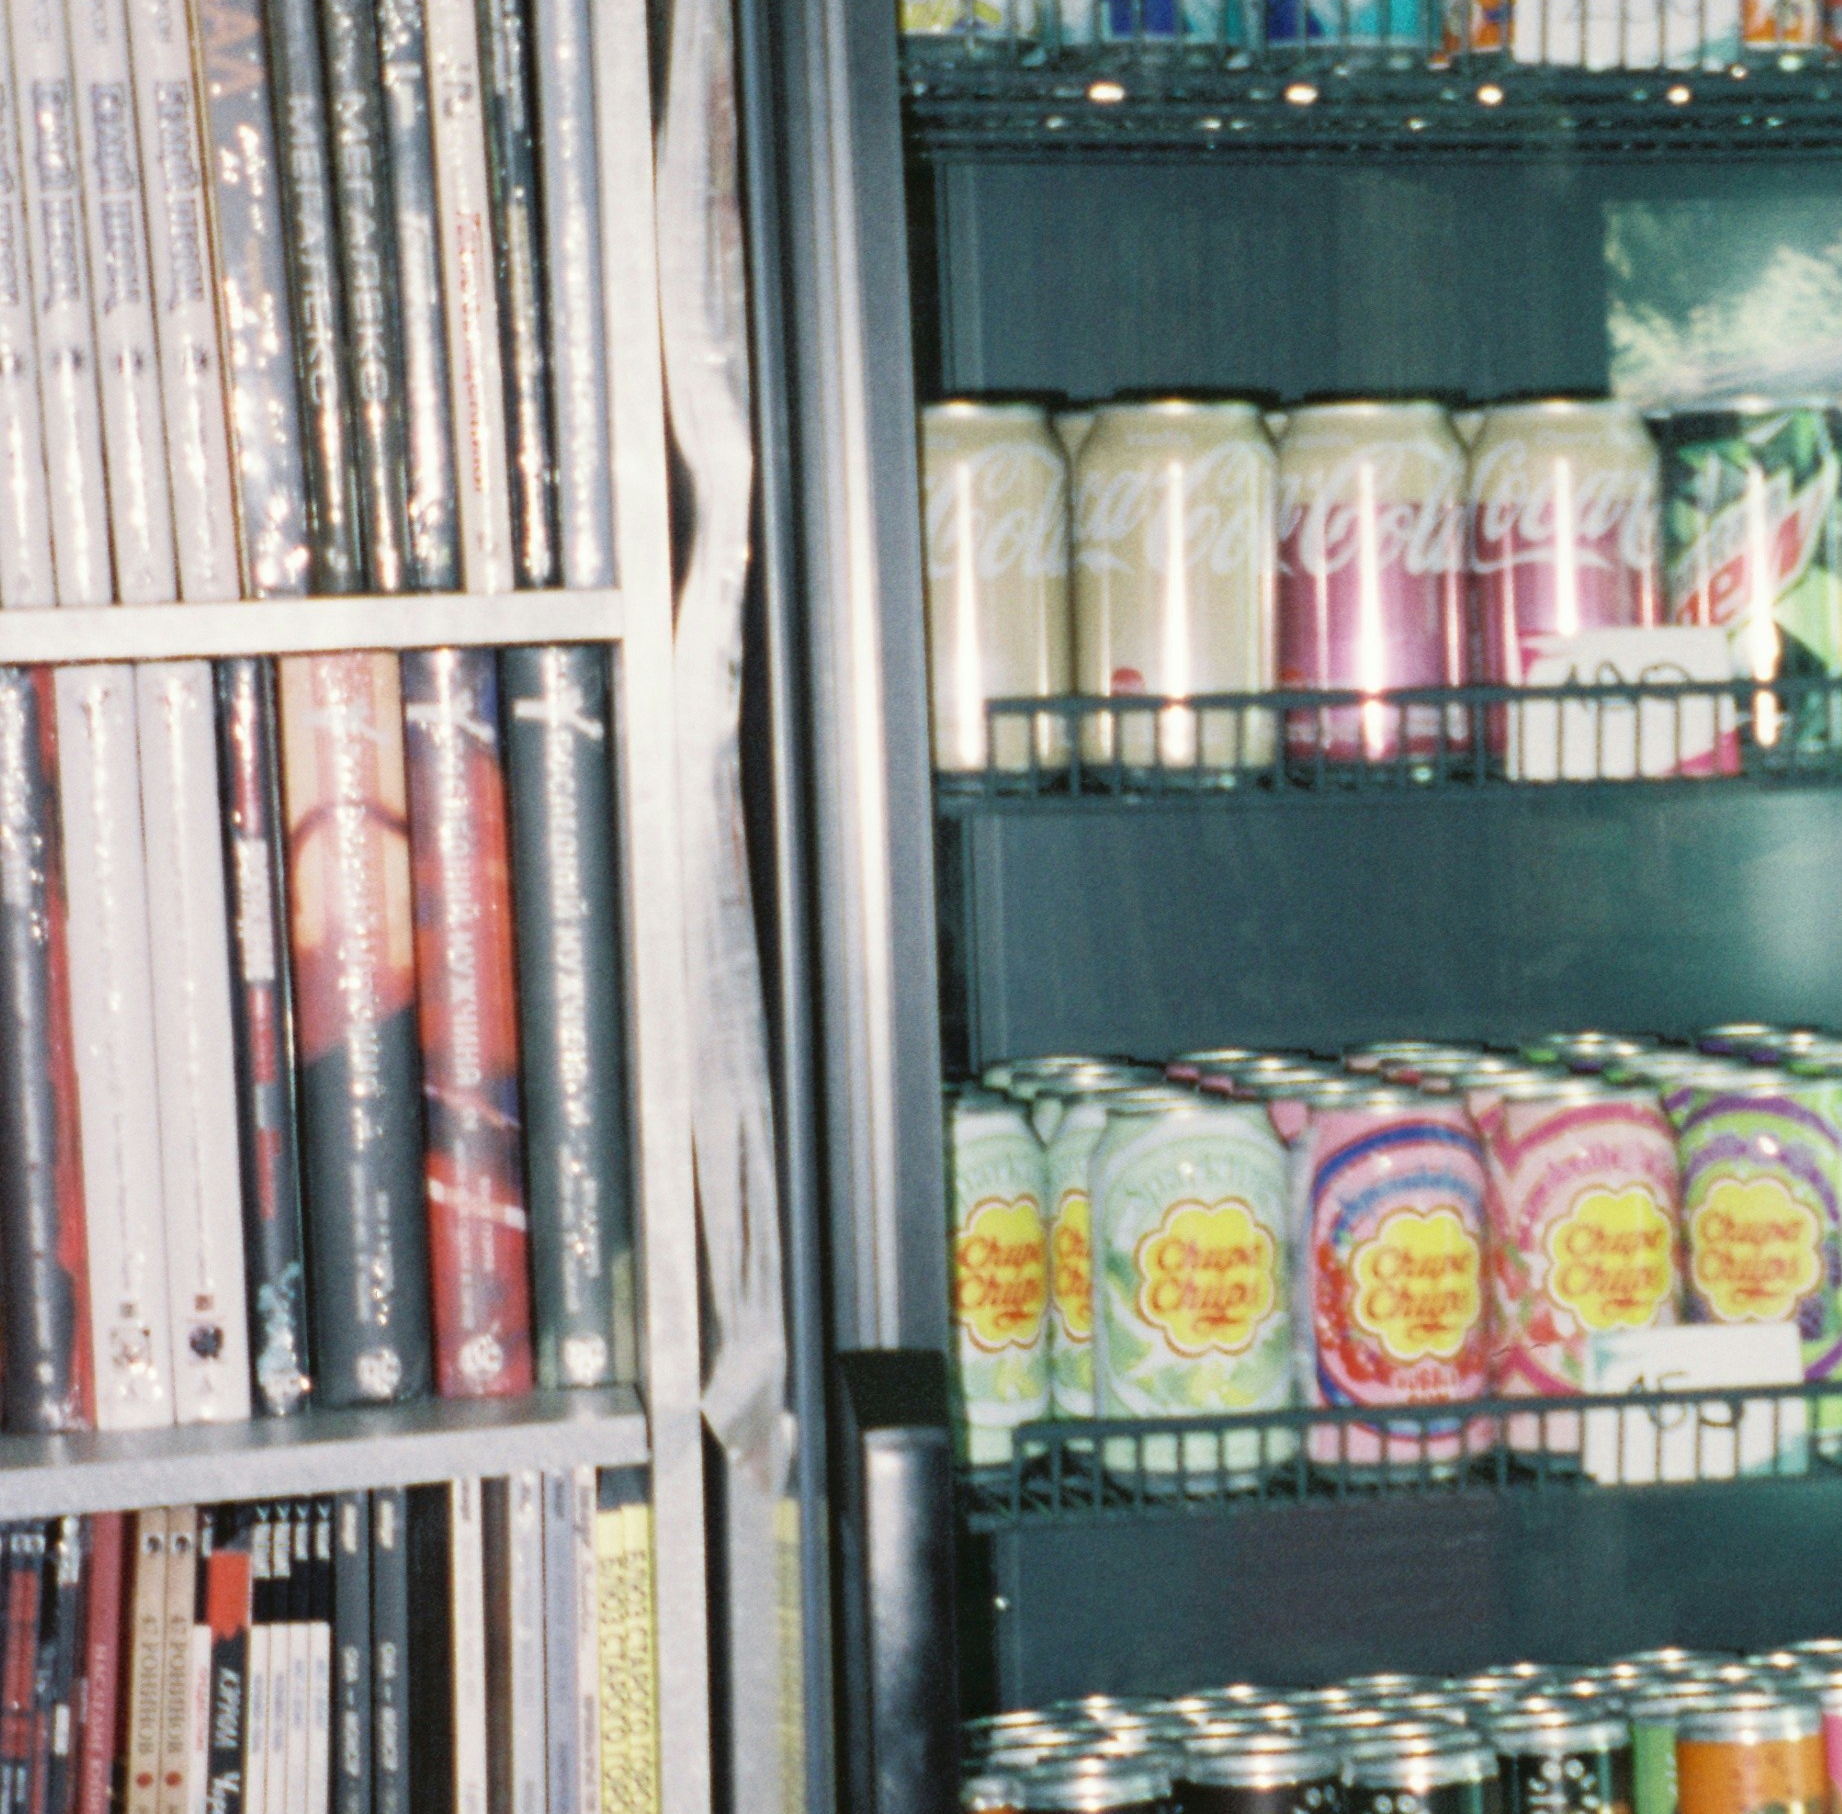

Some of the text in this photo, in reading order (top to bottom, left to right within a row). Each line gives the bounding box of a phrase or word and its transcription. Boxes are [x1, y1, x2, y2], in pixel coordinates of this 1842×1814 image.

[1563, 1225, 1664, 1257] Chupa
[1702, 1211, 1806, 1244] Chupa
[1153, 1234, 1265, 1274] Chupa
[1370, 1245, 1475, 1282] Chupa
